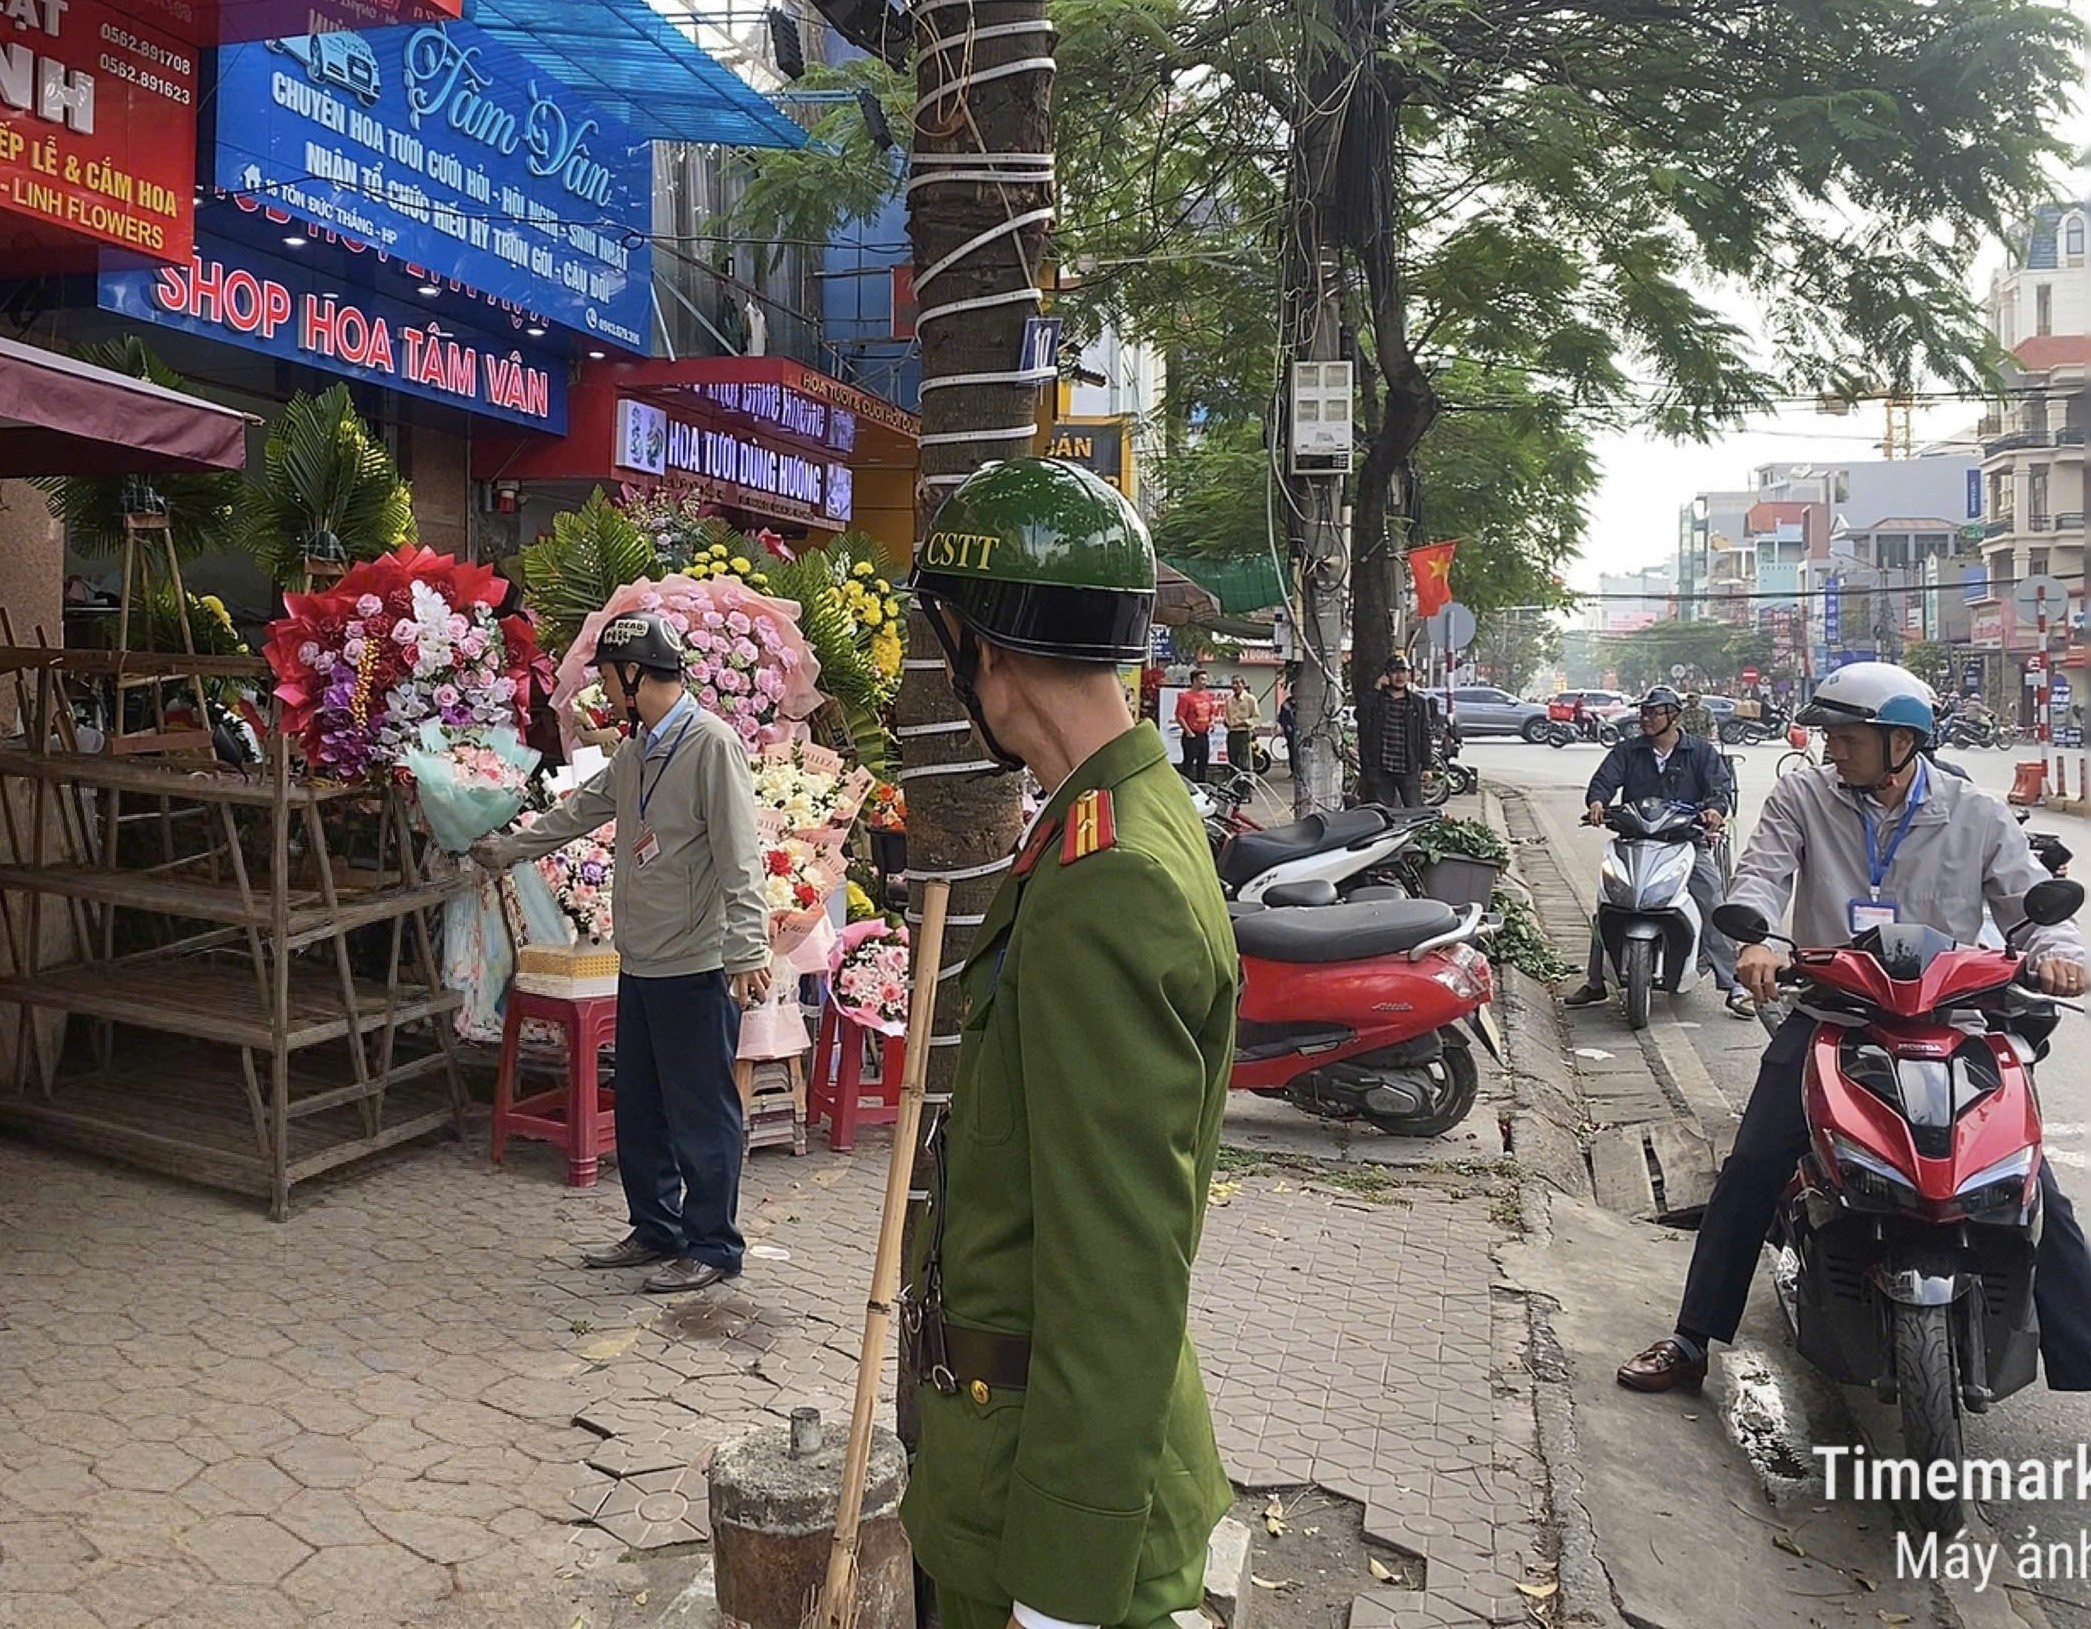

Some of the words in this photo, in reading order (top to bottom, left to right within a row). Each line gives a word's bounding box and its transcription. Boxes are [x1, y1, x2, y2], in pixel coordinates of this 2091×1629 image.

[100, 53, 191, 105] 0562.891623
[101, 22, 191, 75] 0562.891708
[404, 22, 519, 155] Tâm
[524, 78, 613, 207] Vân
[31, 135, 58, 176] LỄ
[64, 155, 81, 184] &
[86, 156, 133, 203] CẮM
[137, 179, 178, 219] HOA
[272, 71, 345, 134] CHUYÊN
[350, 108, 385, 154] HOA
[387, 128, 423, 173] TƯƠI
[428, 149, 463, 192] CƯỚI
[466, 162, 490, 205] HỎI
[568, 224, 597, 256] SINH
[13, 177, 62, 217] LINH
[67, 196, 164, 250] FLOWERS
[281, 184, 306, 208] TÔN
[308, 195, 334, 220] ĐỨC
[335, 207, 375, 238] THẮNG
[381, 226, 398, 246] HP
[304, 140, 358, 193] NHẬN
[531, 246, 554, 281] GÓI
[157, 254, 291, 339] SHOP
[305, 293, 394, 374] HOA
[402, 321, 477, 398] TÂM
[485, 349, 548, 419] VÂN
[1034, 327, 1052, 370] 10
[667, 420, 701, 473] HOA
[704, 430, 737, 482] TƯƠI
[739, 438, 777, 493] DÙNG
[927, 532, 1000, 571] CSTT
